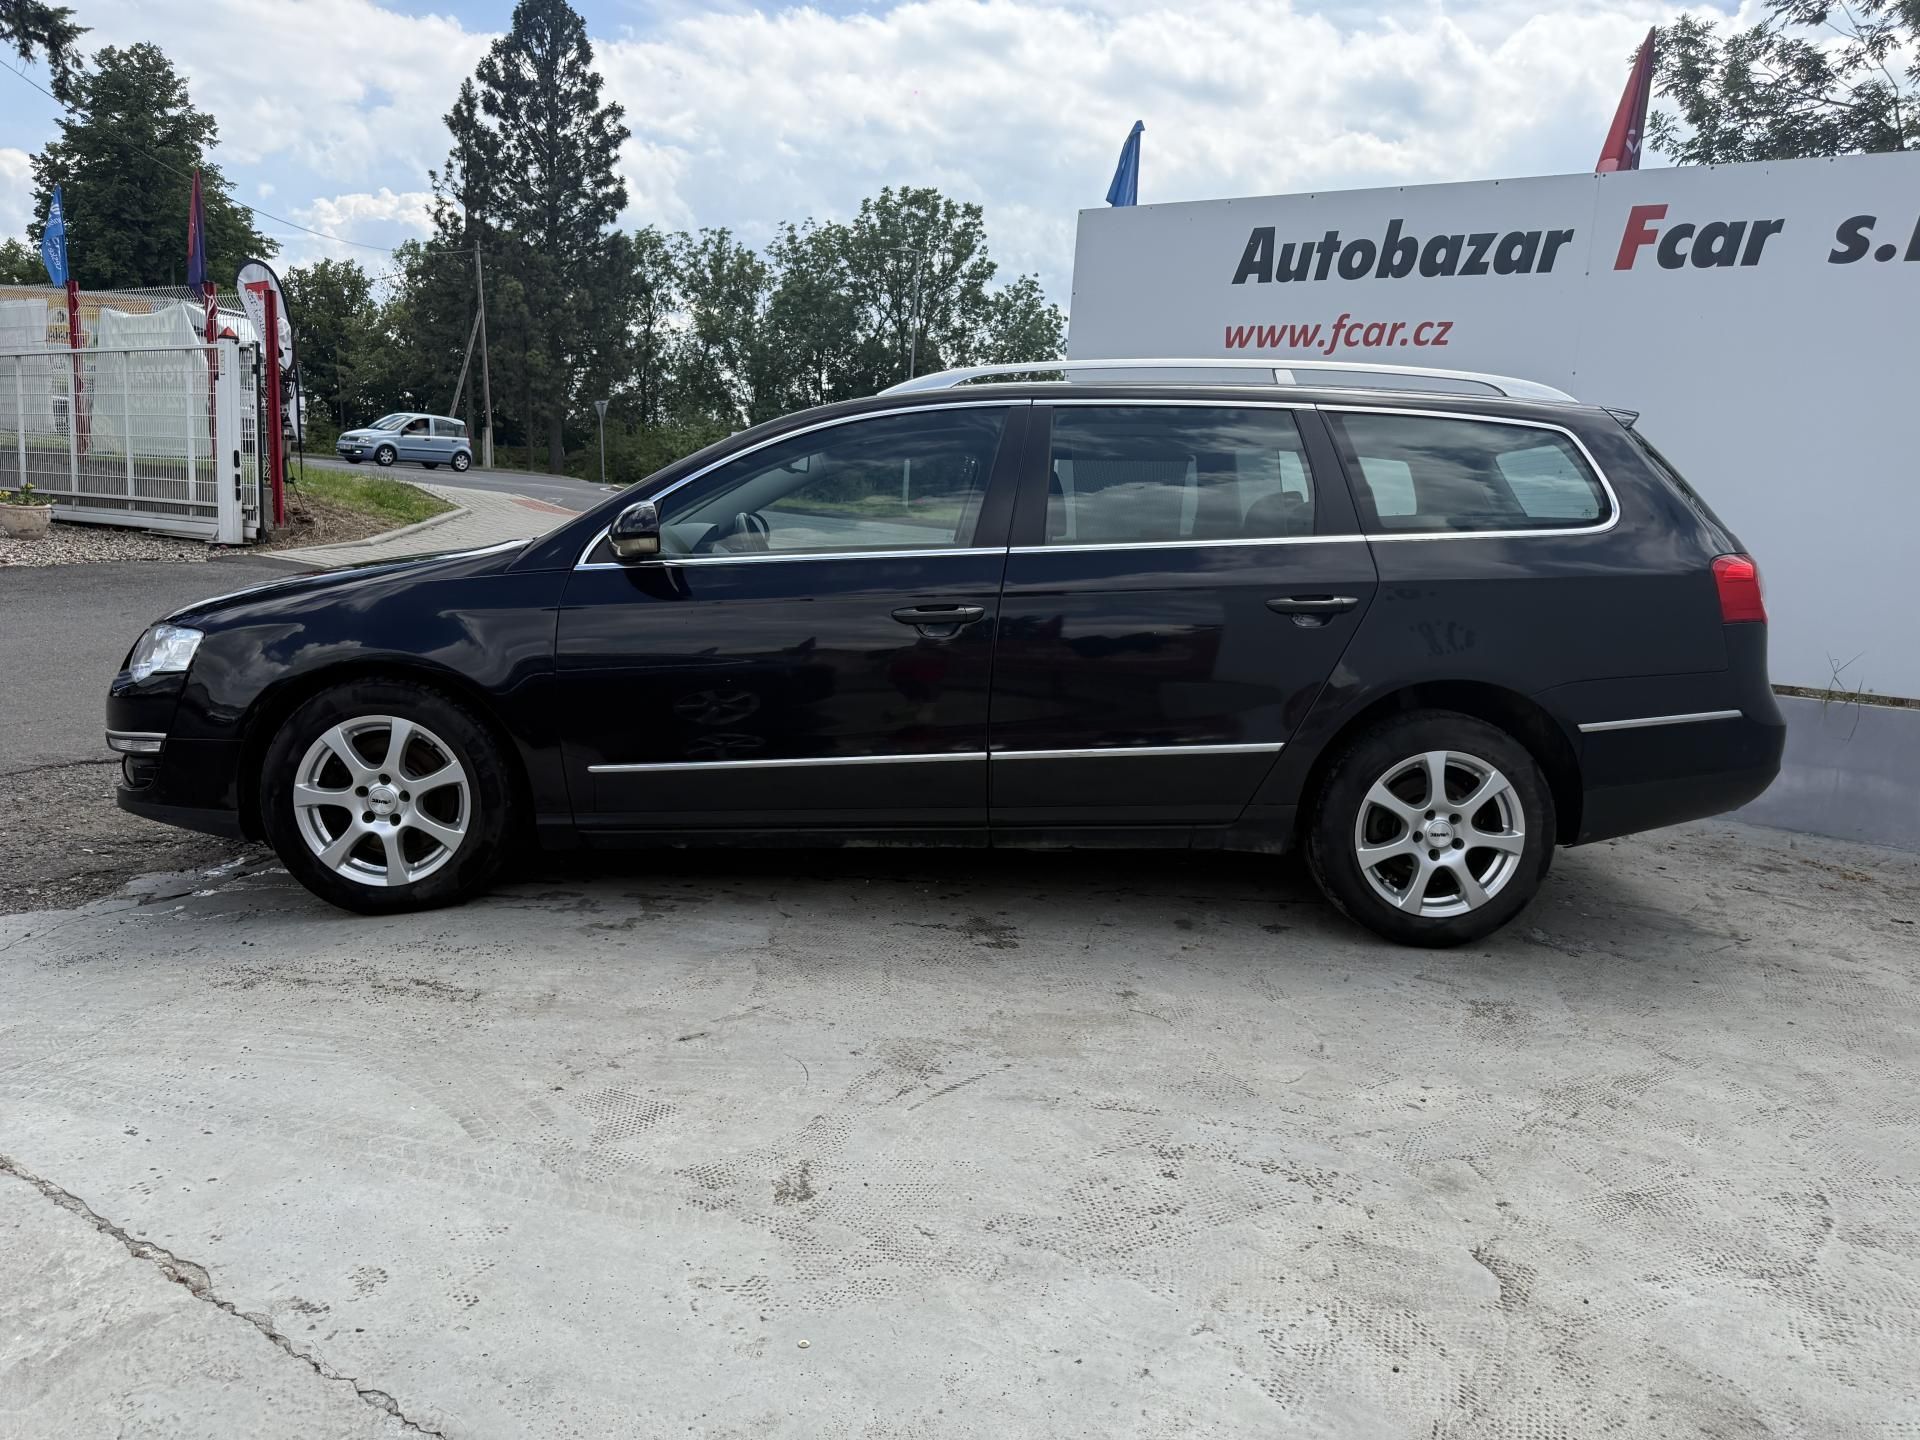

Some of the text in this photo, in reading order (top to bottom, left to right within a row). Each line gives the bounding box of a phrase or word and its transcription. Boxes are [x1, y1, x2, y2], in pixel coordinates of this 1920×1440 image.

[1231, 218, 1575, 285] Autobazar
[1614, 204, 1786, 271] Fcar
[1225, 313, 1454, 356] www.fcar.cz
